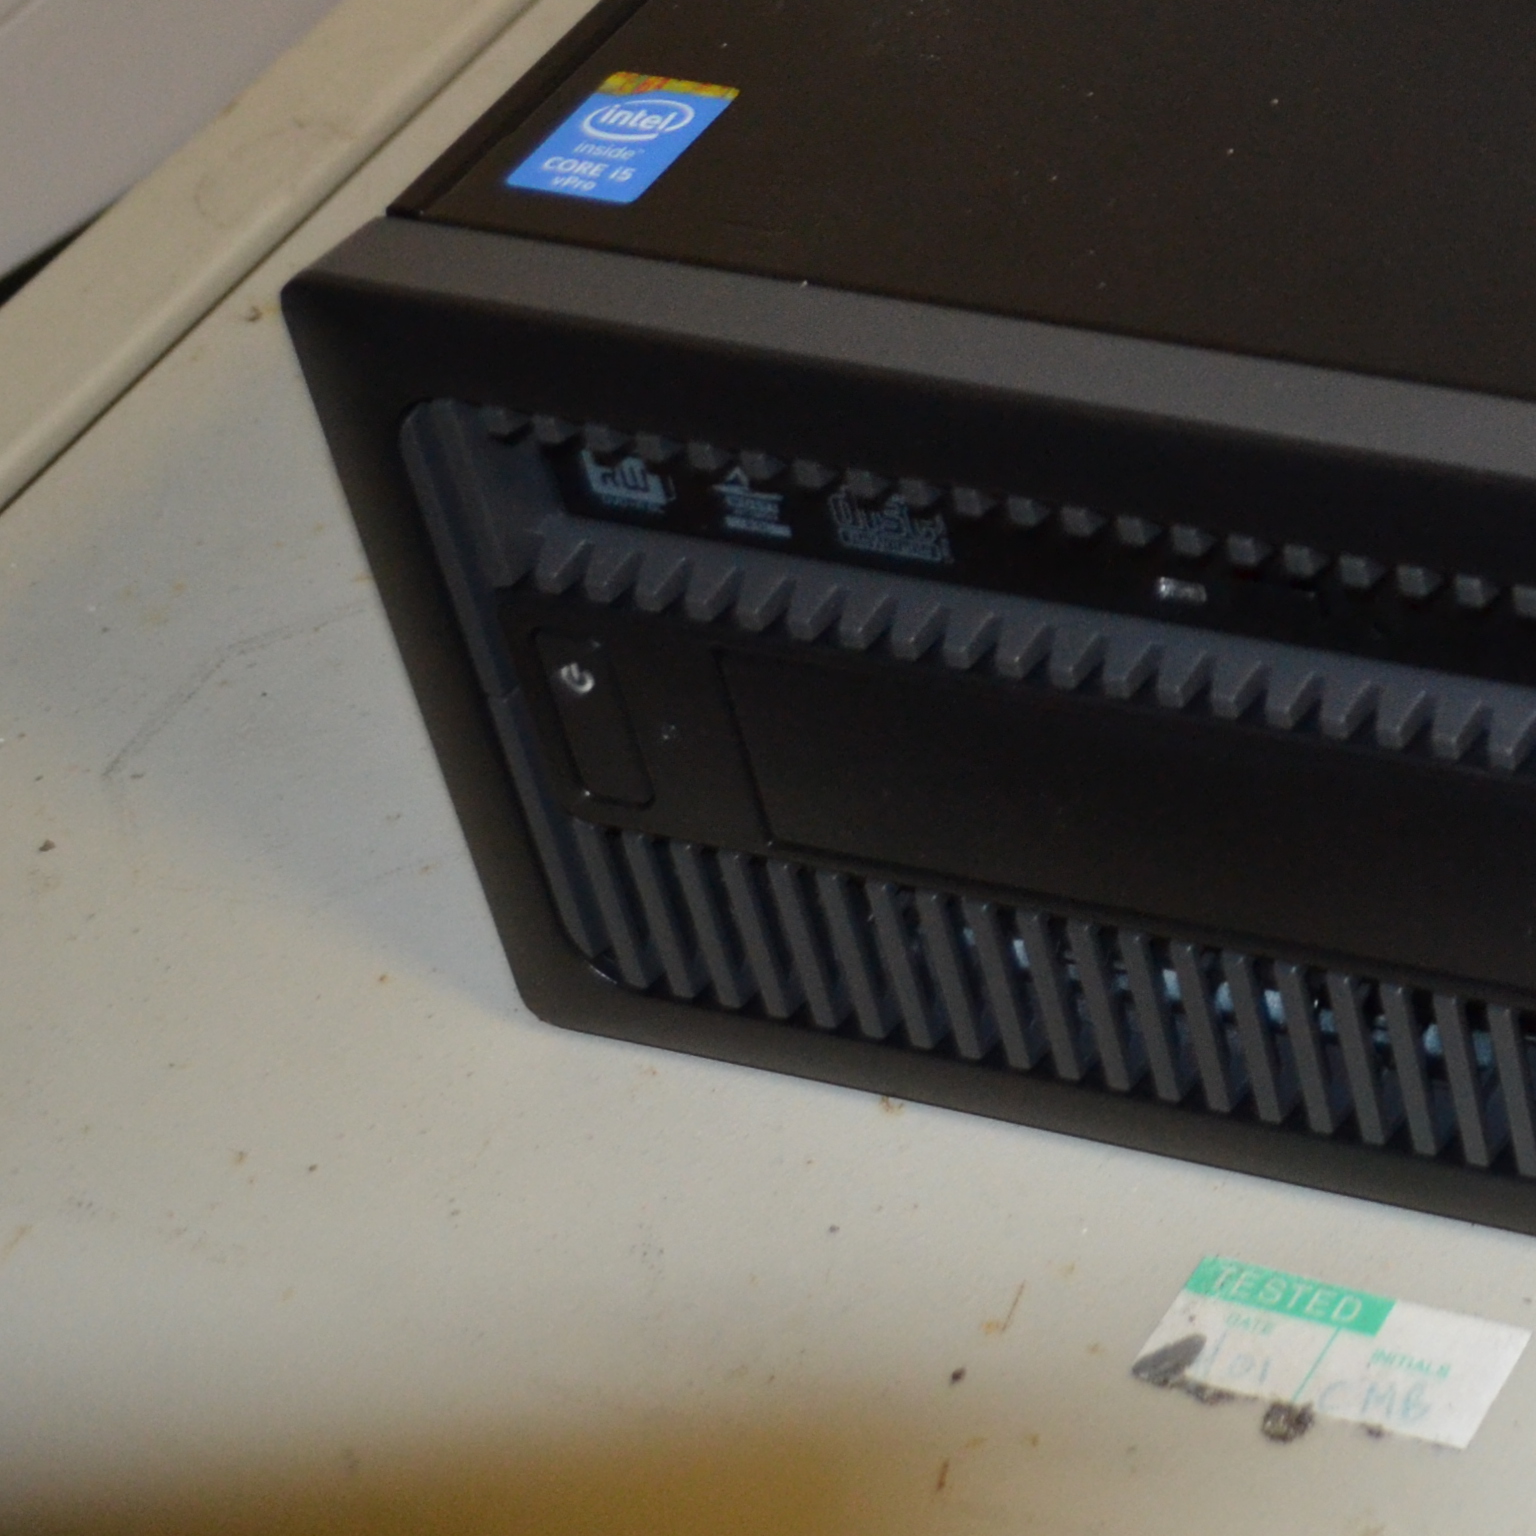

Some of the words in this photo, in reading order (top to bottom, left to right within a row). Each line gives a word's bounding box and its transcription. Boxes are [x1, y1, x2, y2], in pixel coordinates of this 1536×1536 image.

[600, 104, 678, 132] intel
[573, 140, 637, 161] inside
[542, 156, 608, 179] CORE
[608, 166, 636, 183] i5
[552, 176, 597, 192] vPro
[1213, 1264, 1363, 1324] TESTED
